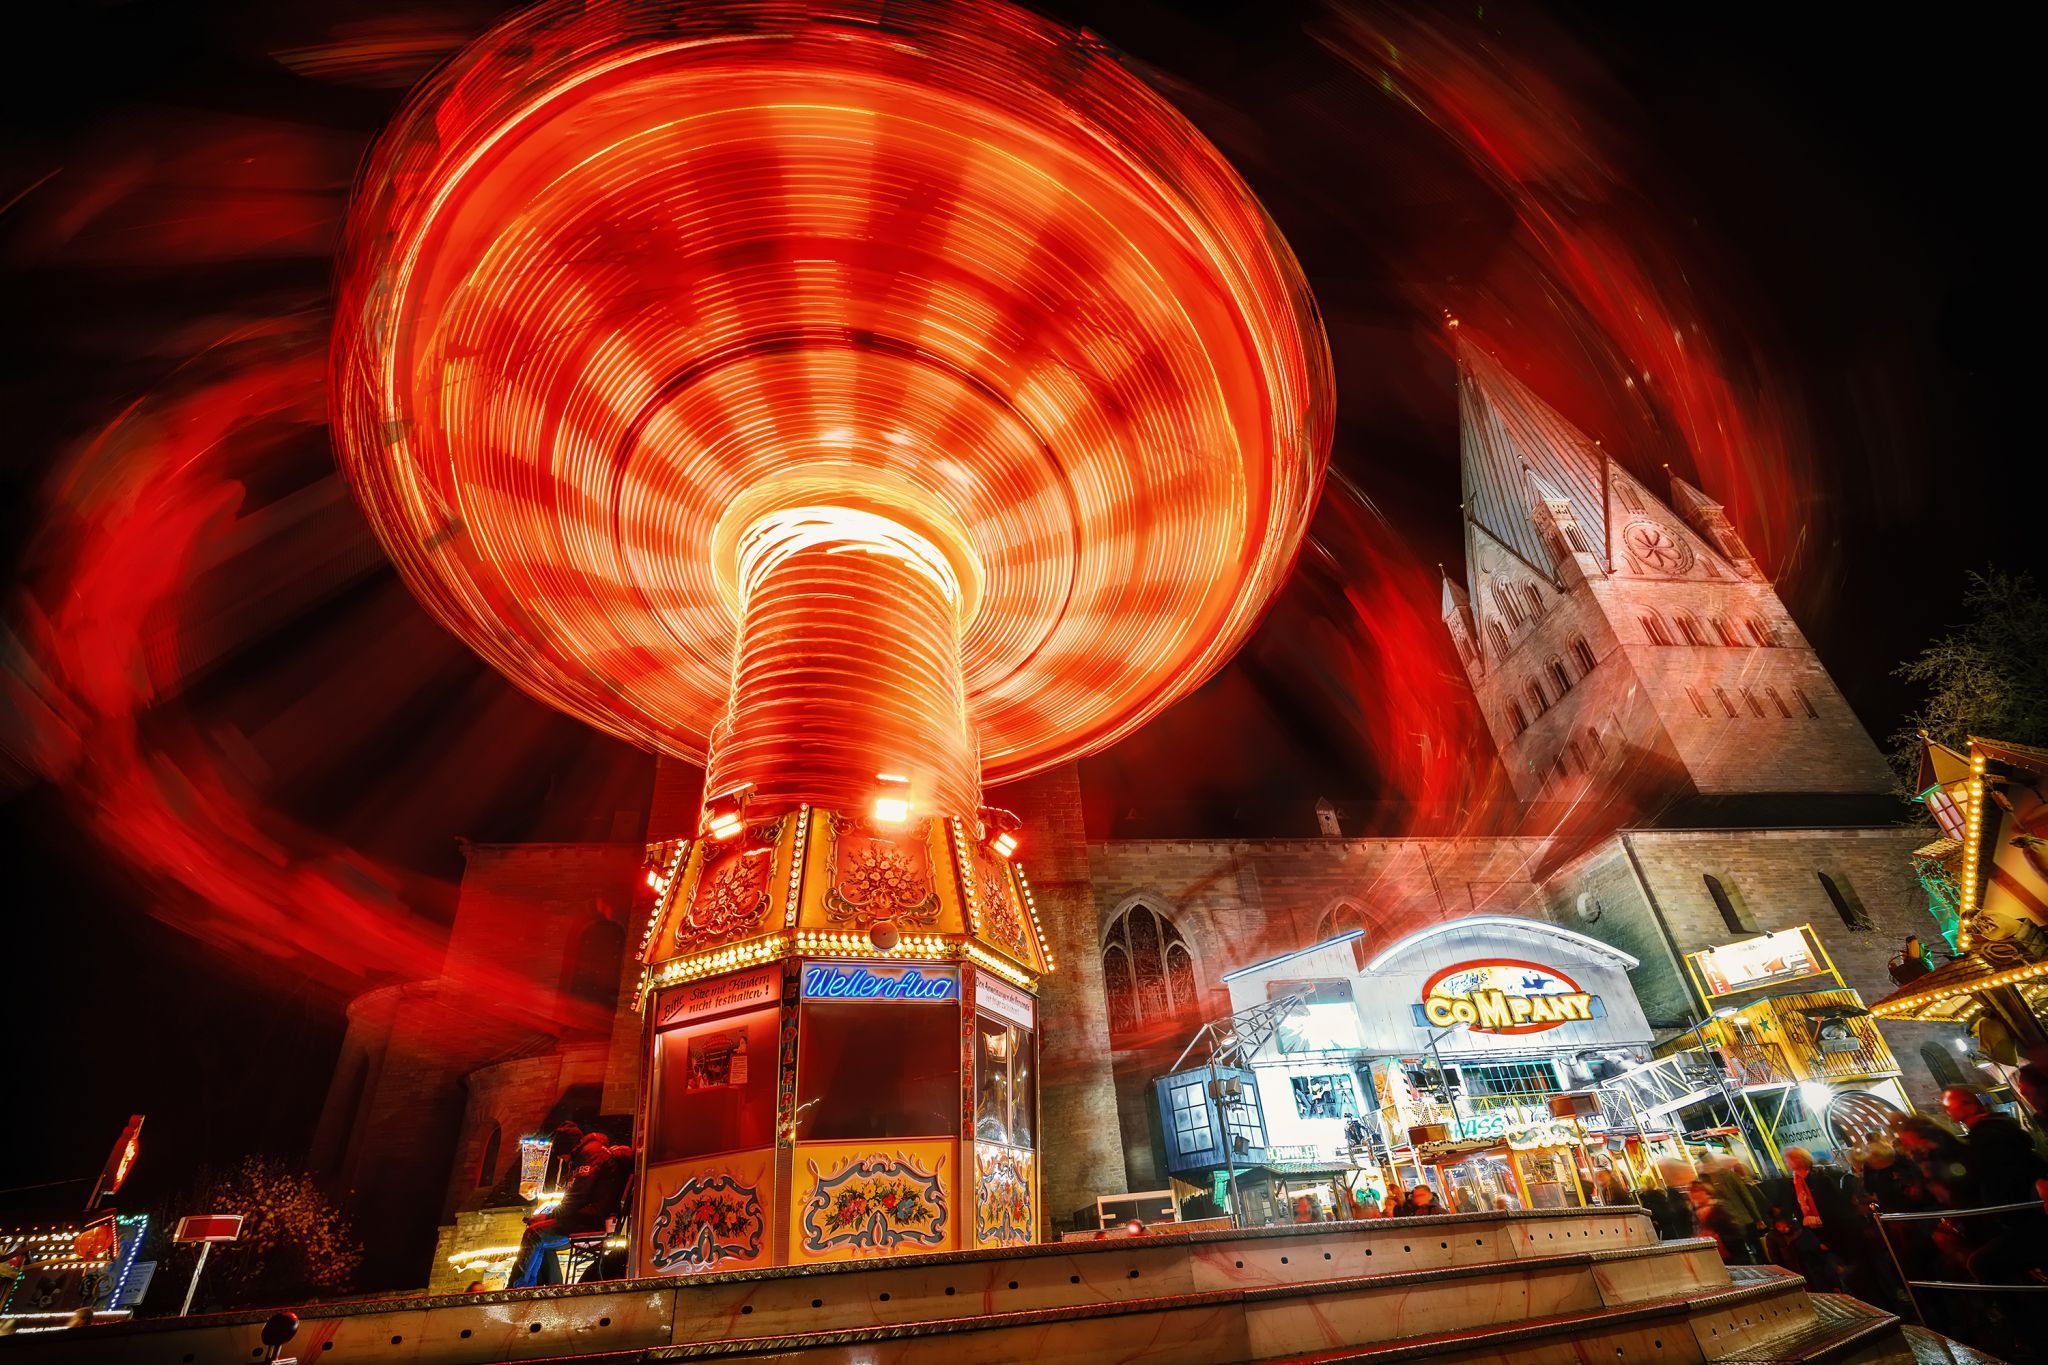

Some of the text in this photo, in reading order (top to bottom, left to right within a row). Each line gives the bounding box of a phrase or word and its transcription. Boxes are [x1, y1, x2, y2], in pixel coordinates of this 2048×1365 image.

[728, 974, 770, 991] Kindern
[661, 994, 685, 1021] Bitte
[689, 1000, 713, 1013] nicht
[1425, 989, 1593, 1030] COMPANY
